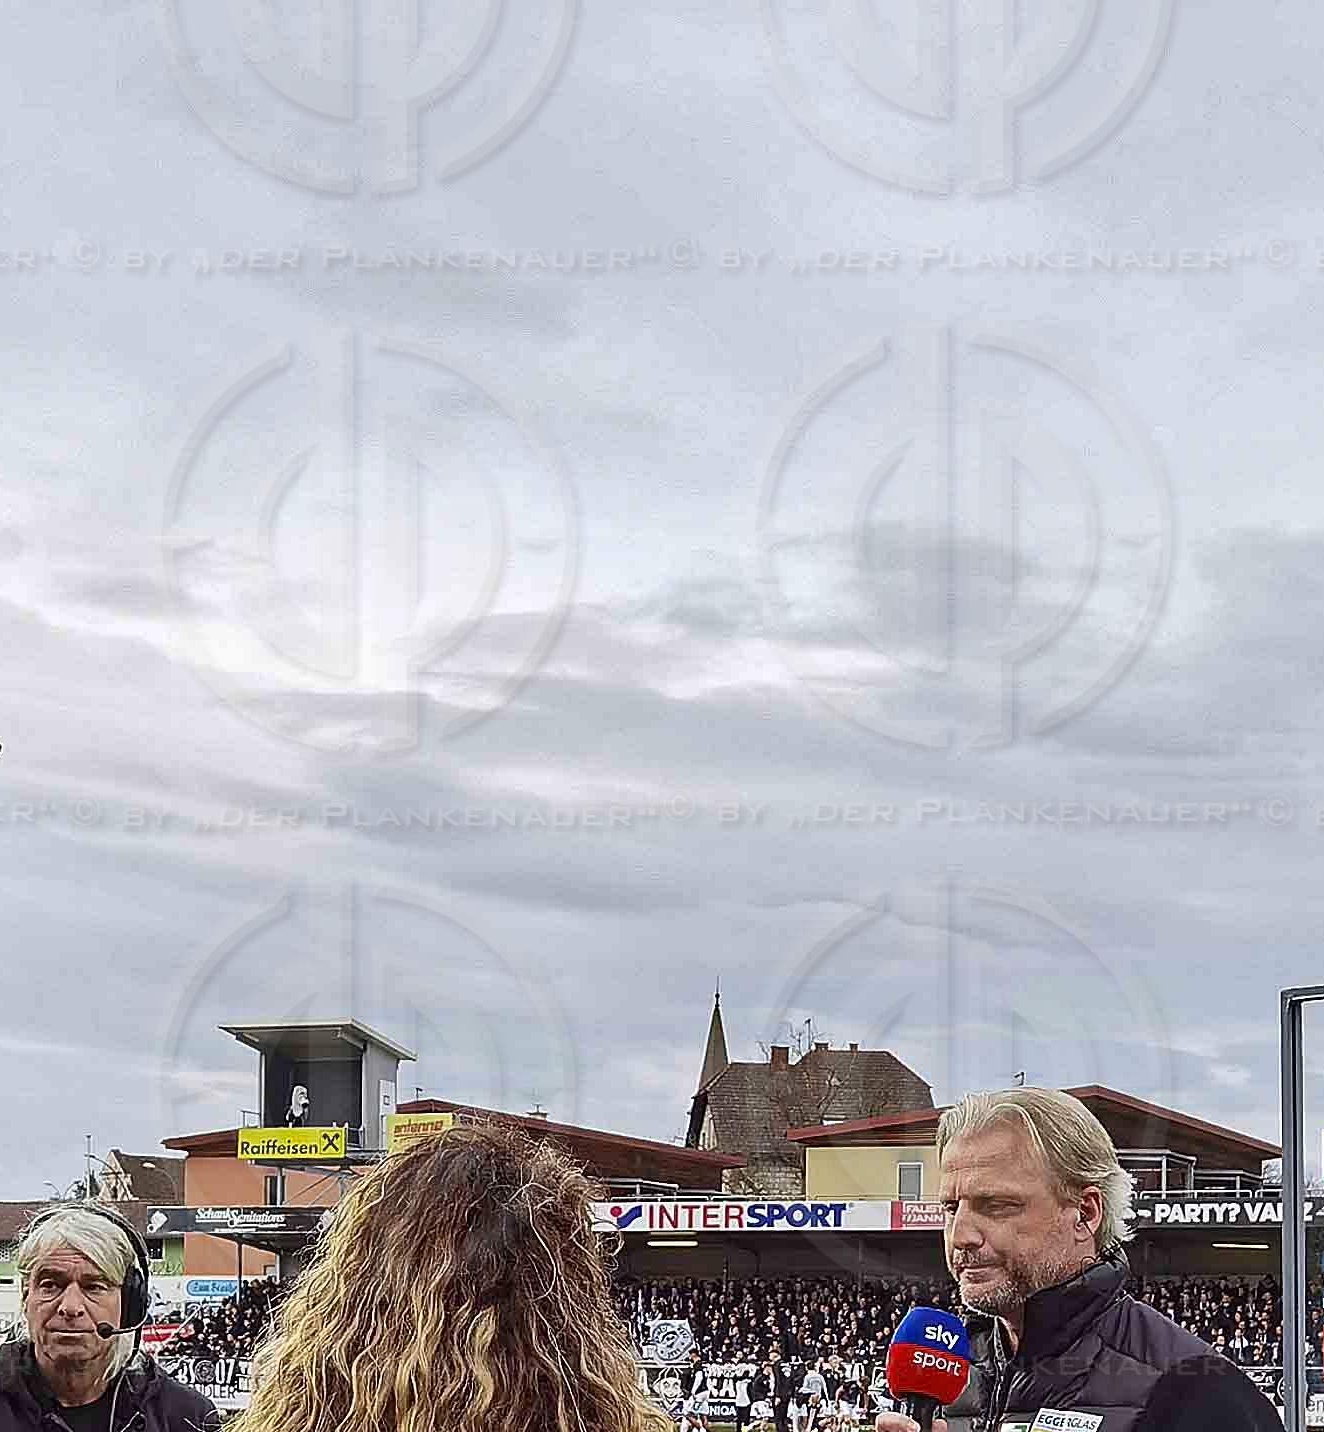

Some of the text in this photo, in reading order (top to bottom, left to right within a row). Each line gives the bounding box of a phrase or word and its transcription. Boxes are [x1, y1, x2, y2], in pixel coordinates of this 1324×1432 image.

[241, 1132, 318, 1156] Raiffeisen
[648, 1203, 846, 1228] INTERSPORT
[1155, 1203, 1240, 1223] PARTY?
[925, 1325, 959, 1349] sky
[913, 1351, 961, 1377] sport
